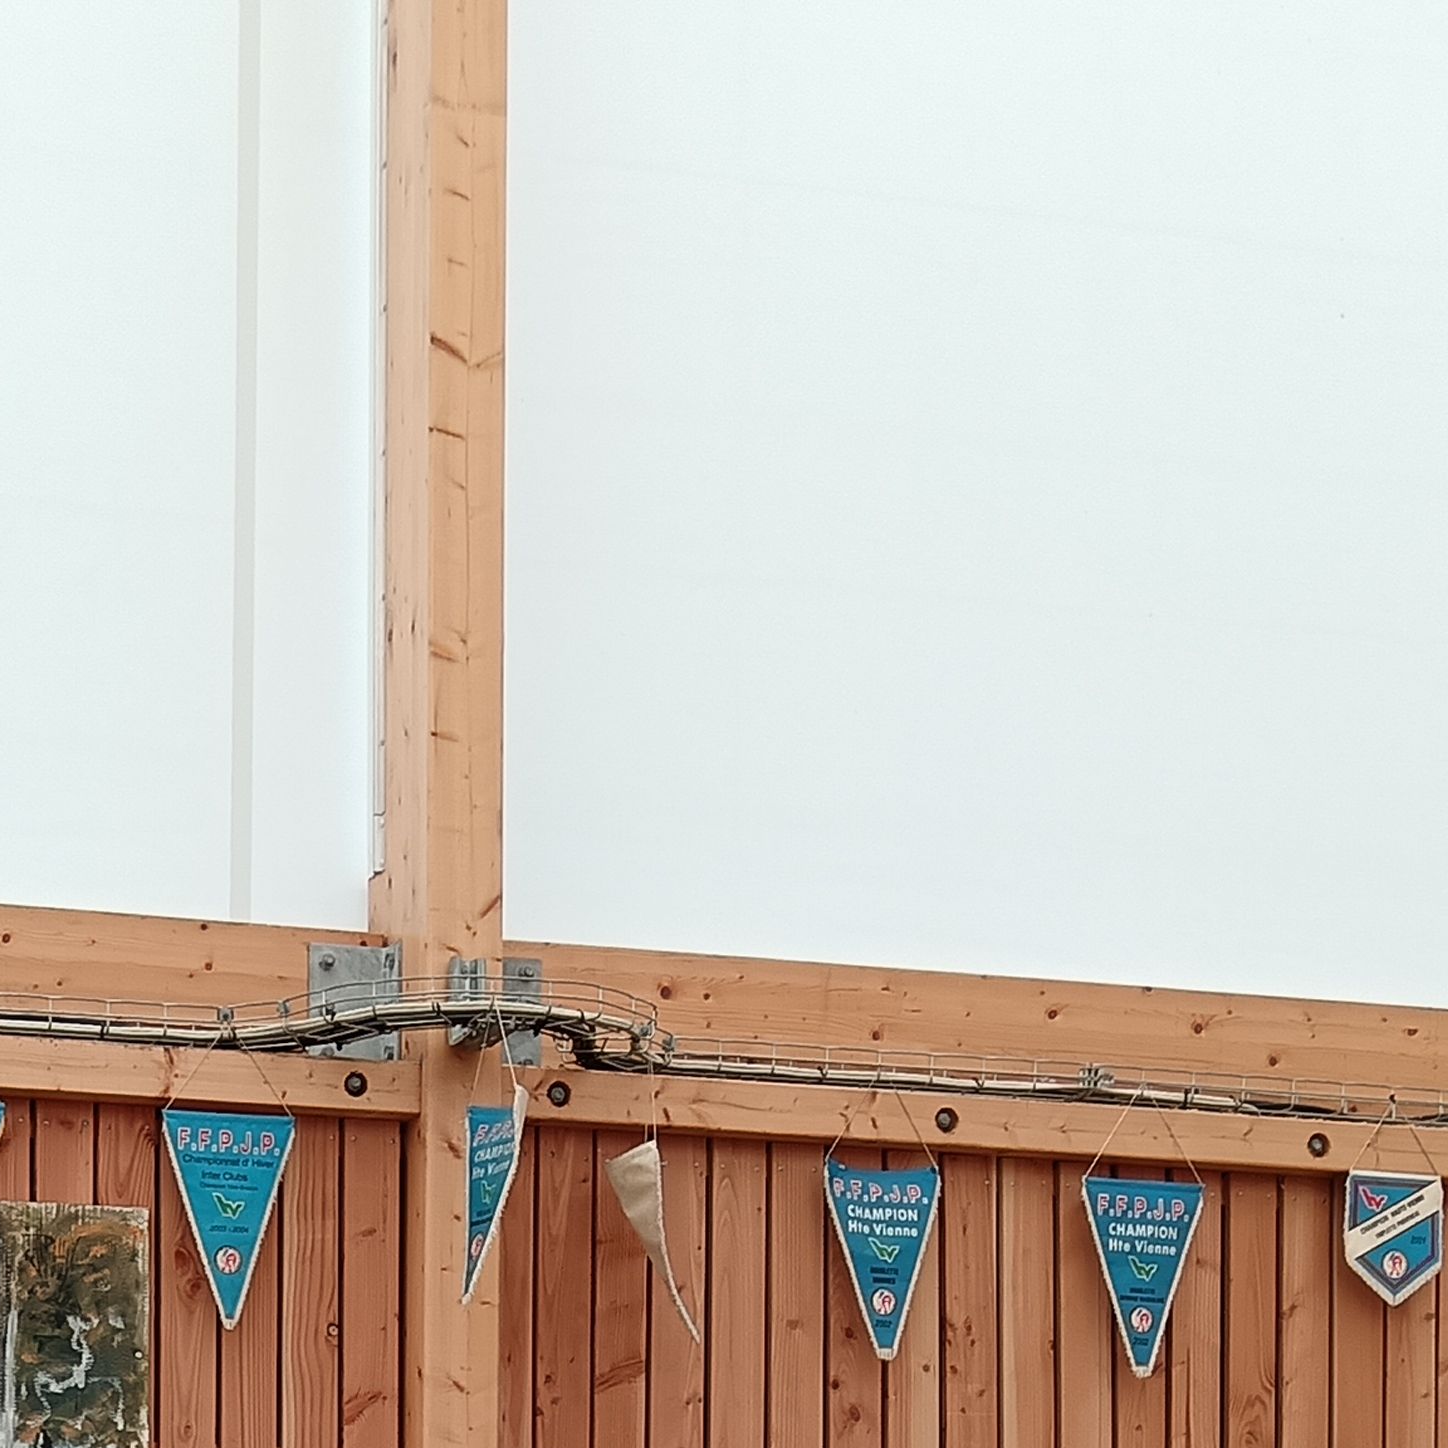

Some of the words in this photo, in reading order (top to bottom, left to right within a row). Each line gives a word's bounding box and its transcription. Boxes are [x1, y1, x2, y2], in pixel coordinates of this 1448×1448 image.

[177, 1127, 280, 1156] F.F.P.J.P.
[833, 1177, 928, 1204] F.F.P.J.P.
[847, 1205, 918, 1221] CHAMPION
[1097, 1193, 1189, 1222] F.F.P.J.P.
[848, 1220, 870, 1234] Hte
[873, 1223, 918, 1237] Vienne
[1108, 1222, 1178, 1239] CHAMPION
[1109, 1239, 1130, 1252] Hte
[1135, 1240, 1176, 1256] Vienne
